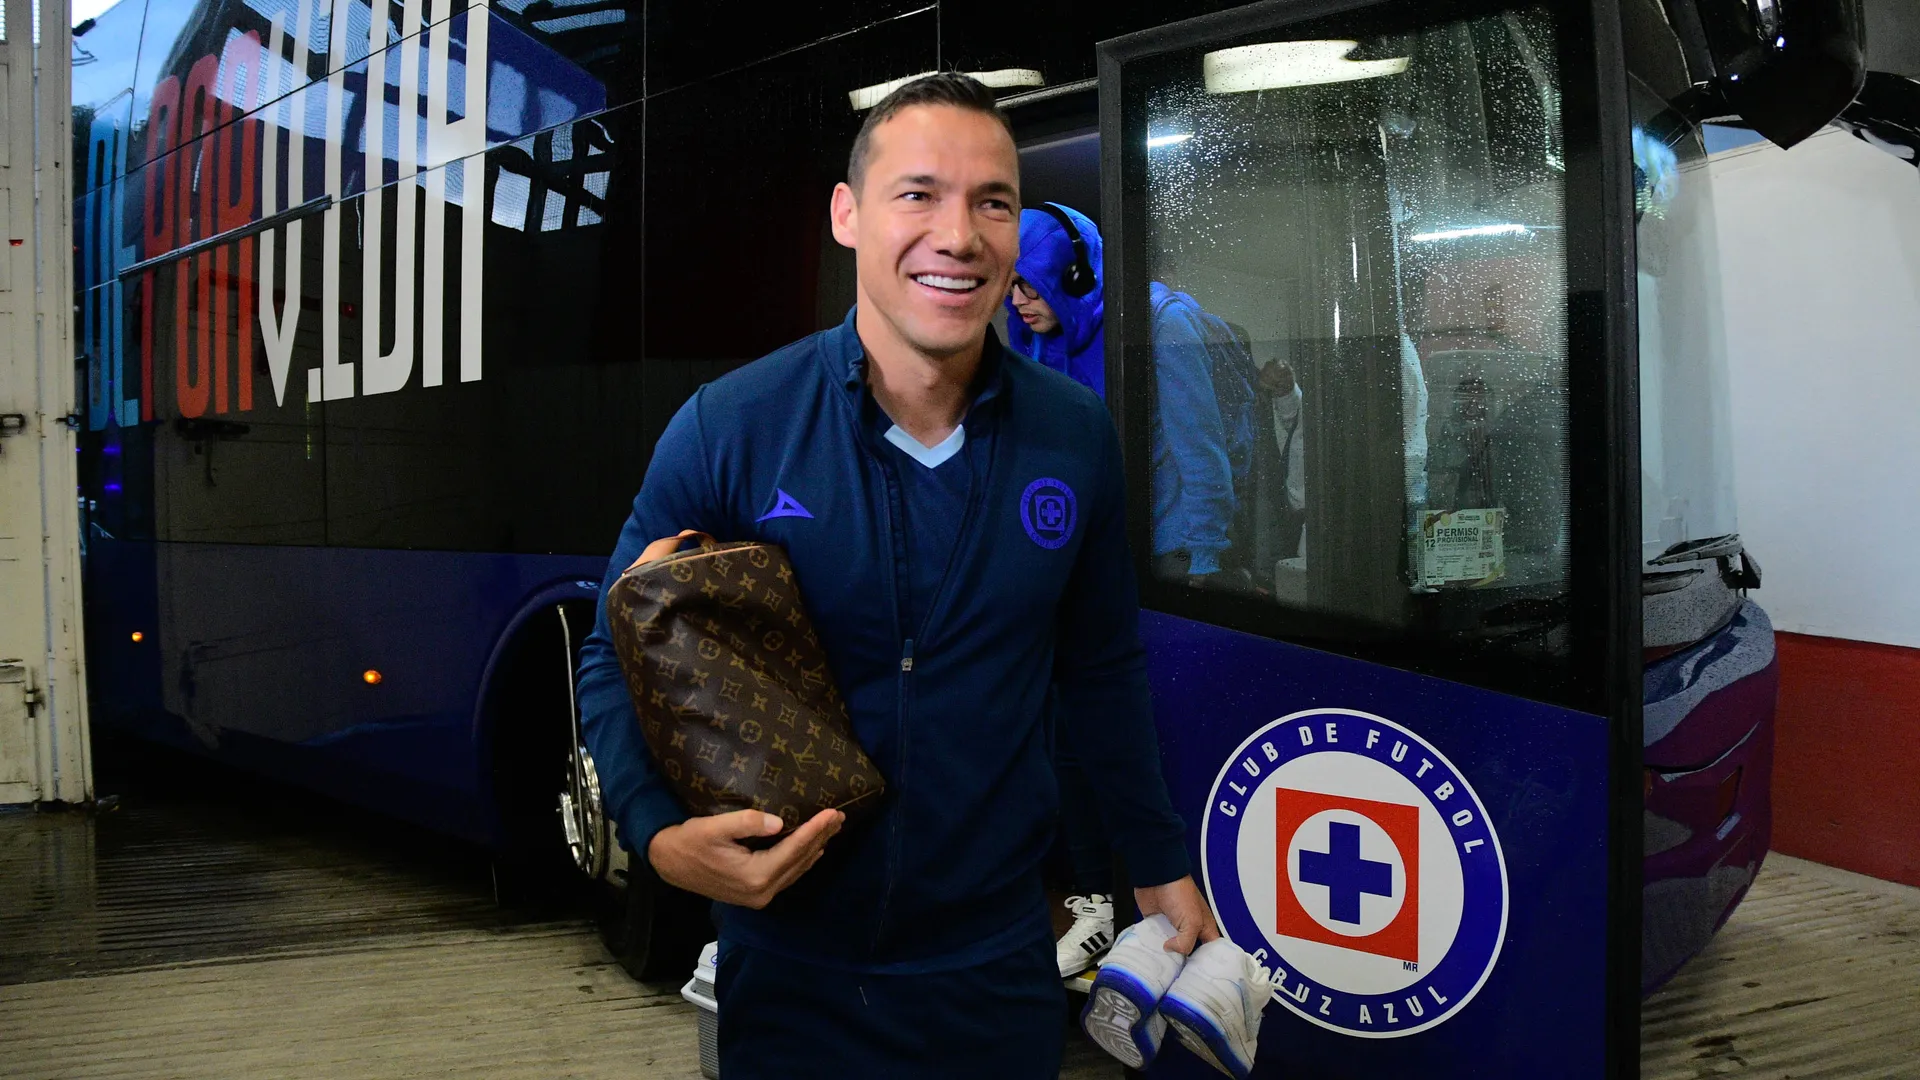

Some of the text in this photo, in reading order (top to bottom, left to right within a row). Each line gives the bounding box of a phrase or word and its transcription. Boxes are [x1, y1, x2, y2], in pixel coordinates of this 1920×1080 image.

[142, 29, 263, 421] POR
[259, 0, 489, 407] VIDA
[1438, 527, 1478, 536] PERMISO
[1425, 539, 1436, 548] 12
[1438, 536, 1478, 544] PROVISIONAL
[1219, 723, 1485, 854] CLUB DE FUTBOL
[1402, 961, 1419, 973] MR
[1252, 947, 1448, 1025] CRUZ AZUL
